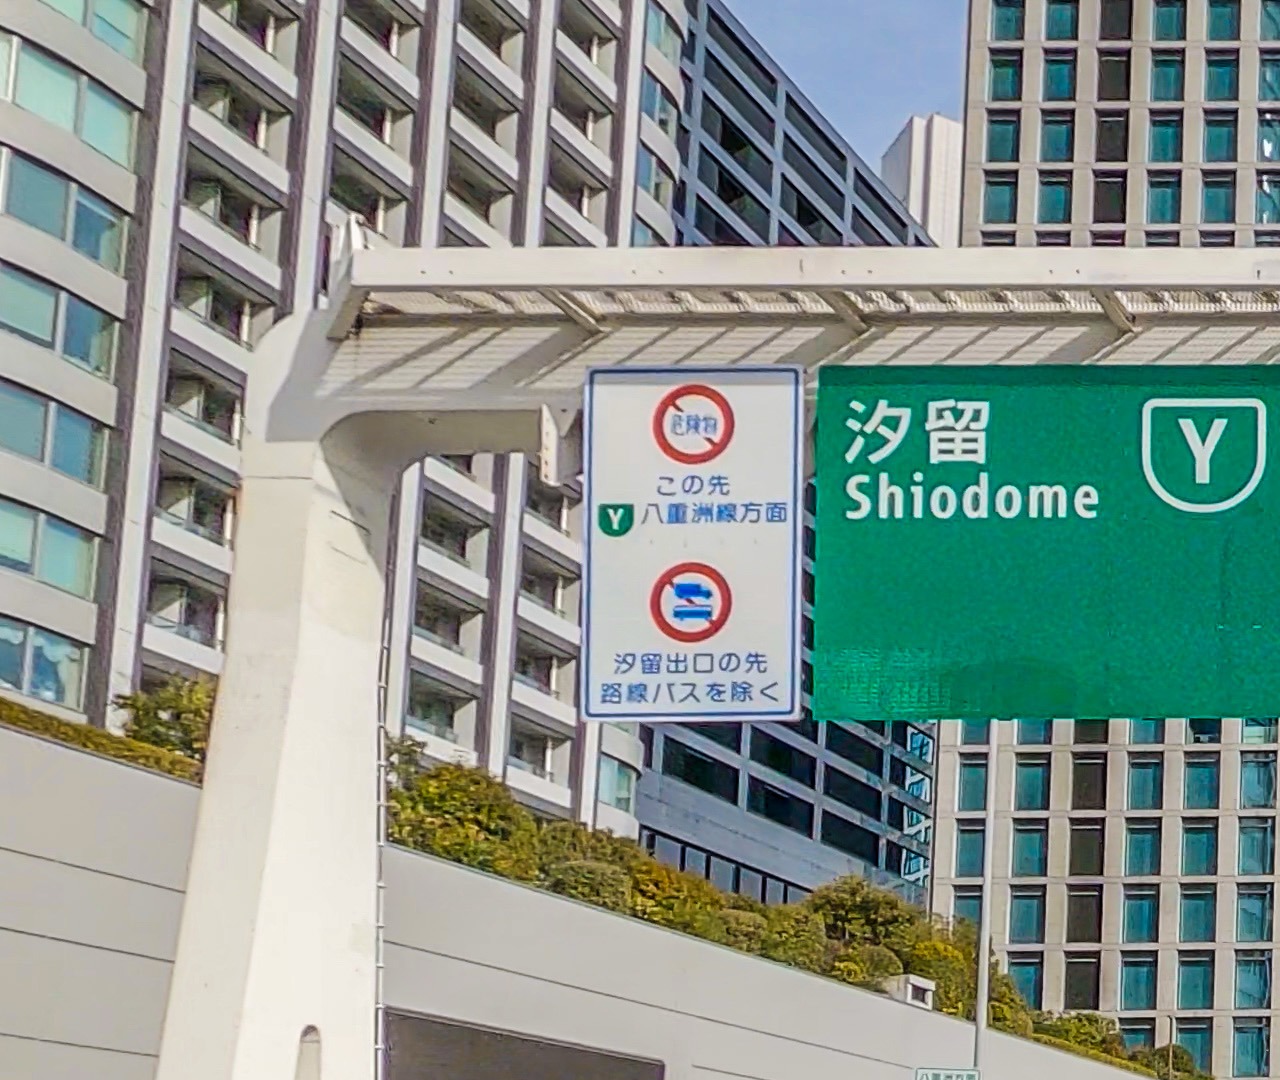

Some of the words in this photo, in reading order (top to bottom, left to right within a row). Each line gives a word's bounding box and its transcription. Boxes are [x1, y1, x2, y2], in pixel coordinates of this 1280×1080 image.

[844, 398, 990, 465] 汐留
[1178, 418, 1228, 484] Y
[656, 475, 730, 496] この先
[845, 472, 1099, 520] Shiodome
[605, 508, 624, 530] Y
[641, 502, 788, 524] 八重洲線方面
[614, 652, 768, 675] 汐留出口の先
[600, 682, 779, 704] 路線バスを除く
